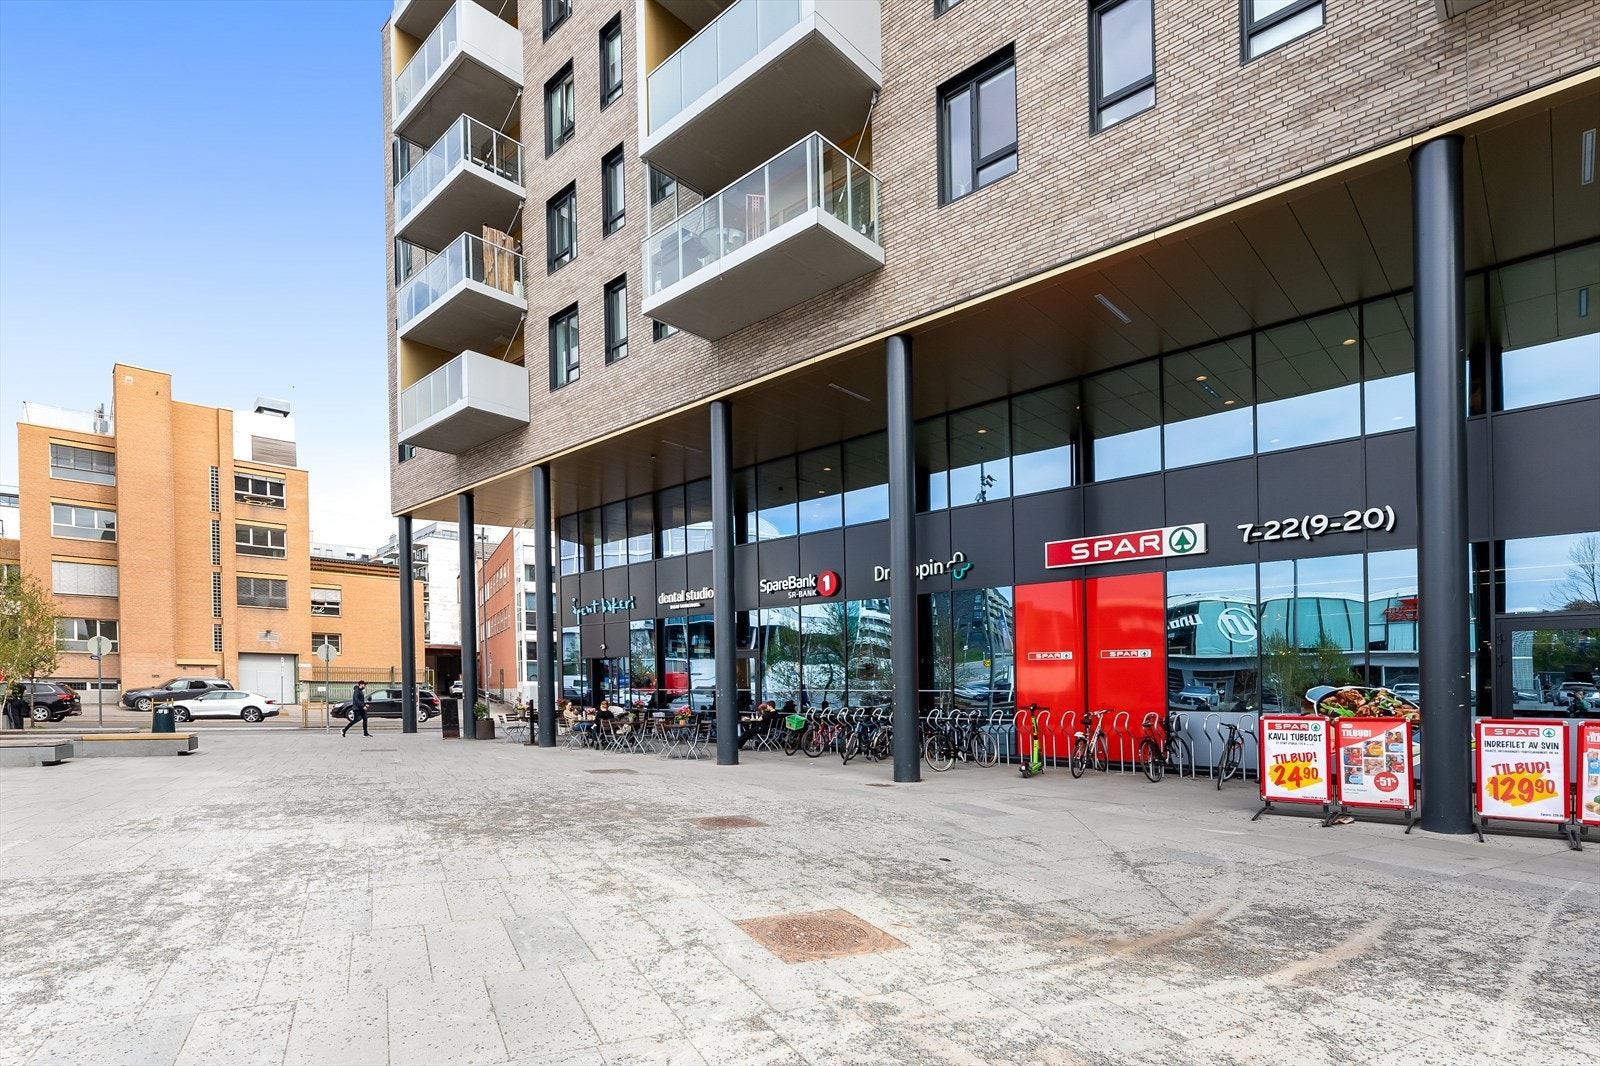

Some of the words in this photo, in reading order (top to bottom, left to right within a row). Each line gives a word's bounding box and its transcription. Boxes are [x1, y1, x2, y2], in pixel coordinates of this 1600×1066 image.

[1237, 505, 1395, 543] 7-22(9-20)
[1071, 534, 1160, 560] SPAR
[760, 573, 816, 594] SpareBank
[822, 574, 831, 592] 1
[658, 589, 685, 604] dental
[685, 586, 714, 601] studio
[787, 589, 817, 599] SR-BANK
[601, 595, 635, 614] bakeri
[1268, 732, 1289, 741] KAVLI
[1290, 733, 1322, 742] TUBEOST
[1342, 729, 1372, 738] TILBUD!
[1494, 728, 1539, 736] SPAR
[1484, 740, 1525, 749] INDREFILET
[1528, 741, 1539, 749] AV
[1541, 742, 1559, 750] SVIN
[1272, 752, 1318, 765] TILBUD!
[1491, 761, 1551, 775] TILBUD!
